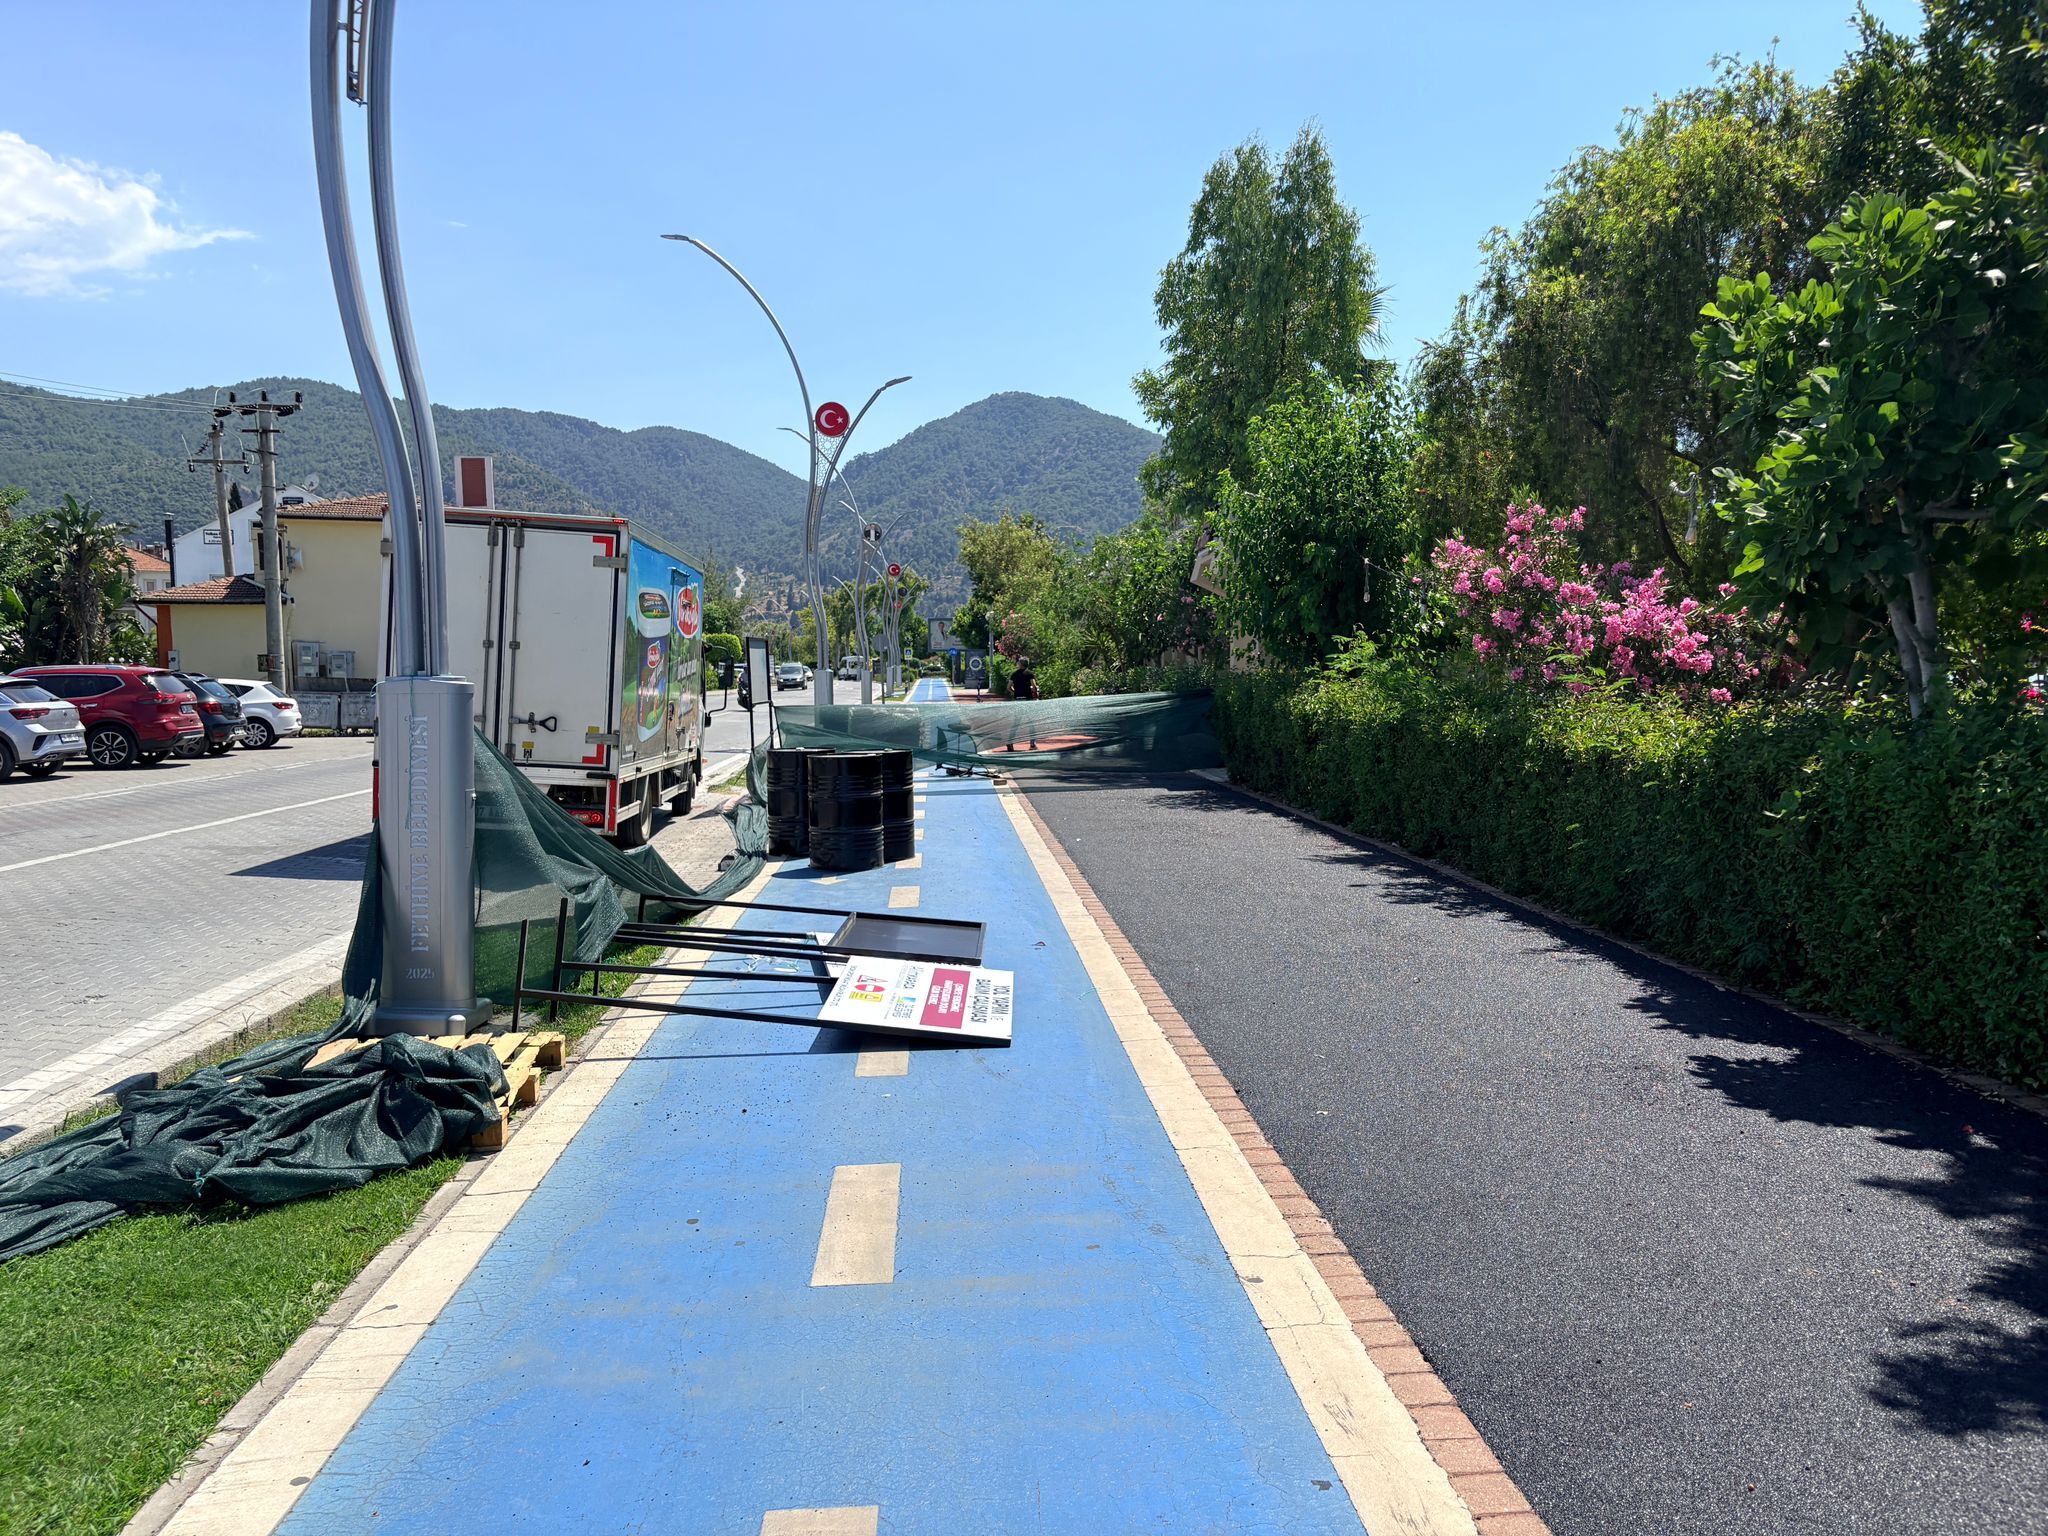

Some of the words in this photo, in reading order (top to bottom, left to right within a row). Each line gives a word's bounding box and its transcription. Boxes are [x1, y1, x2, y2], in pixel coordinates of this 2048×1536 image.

[404, 715, 429, 849] BELEDİYESİ
[405, 854, 429, 952] FETHİYE
[405, 967, 435, 980] 2025
[974, 978, 991, 995] BAKIM
[992, 985, 1011, 996] YOL
[967, 995, 990, 1024] ÇALIŞMASI
[991, 996, 1010, 1015] YAPIM
